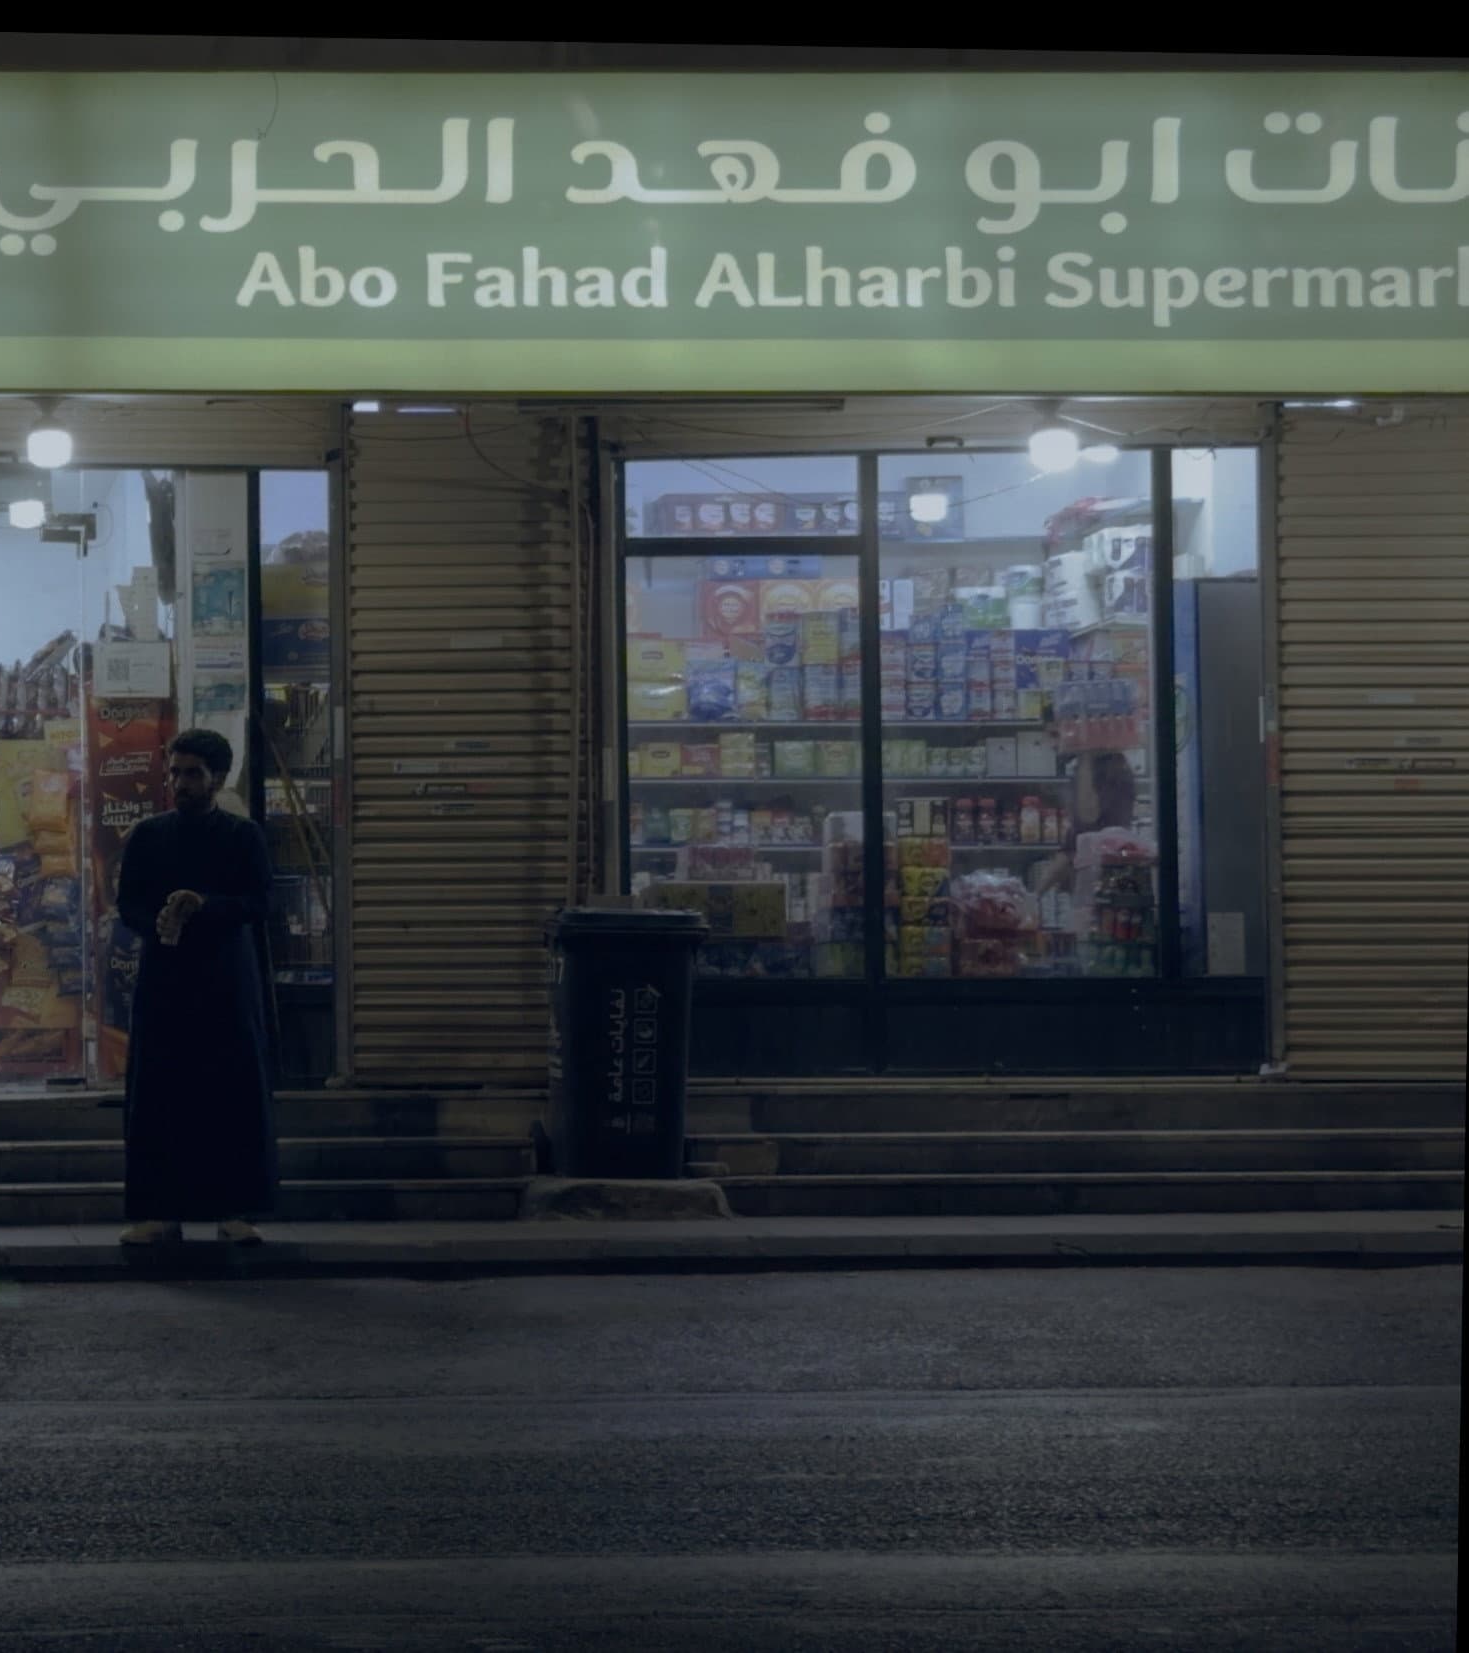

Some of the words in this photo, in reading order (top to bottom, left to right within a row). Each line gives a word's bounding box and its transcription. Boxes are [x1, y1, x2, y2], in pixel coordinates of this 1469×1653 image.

[566, 112, 917, 204] فهد
[967, 117, 1181, 234] ابو
[236, 246, 398, 307] Abo
[427, 246, 668, 307] Fahad
[695, 246, 1015, 308] ALharbi
